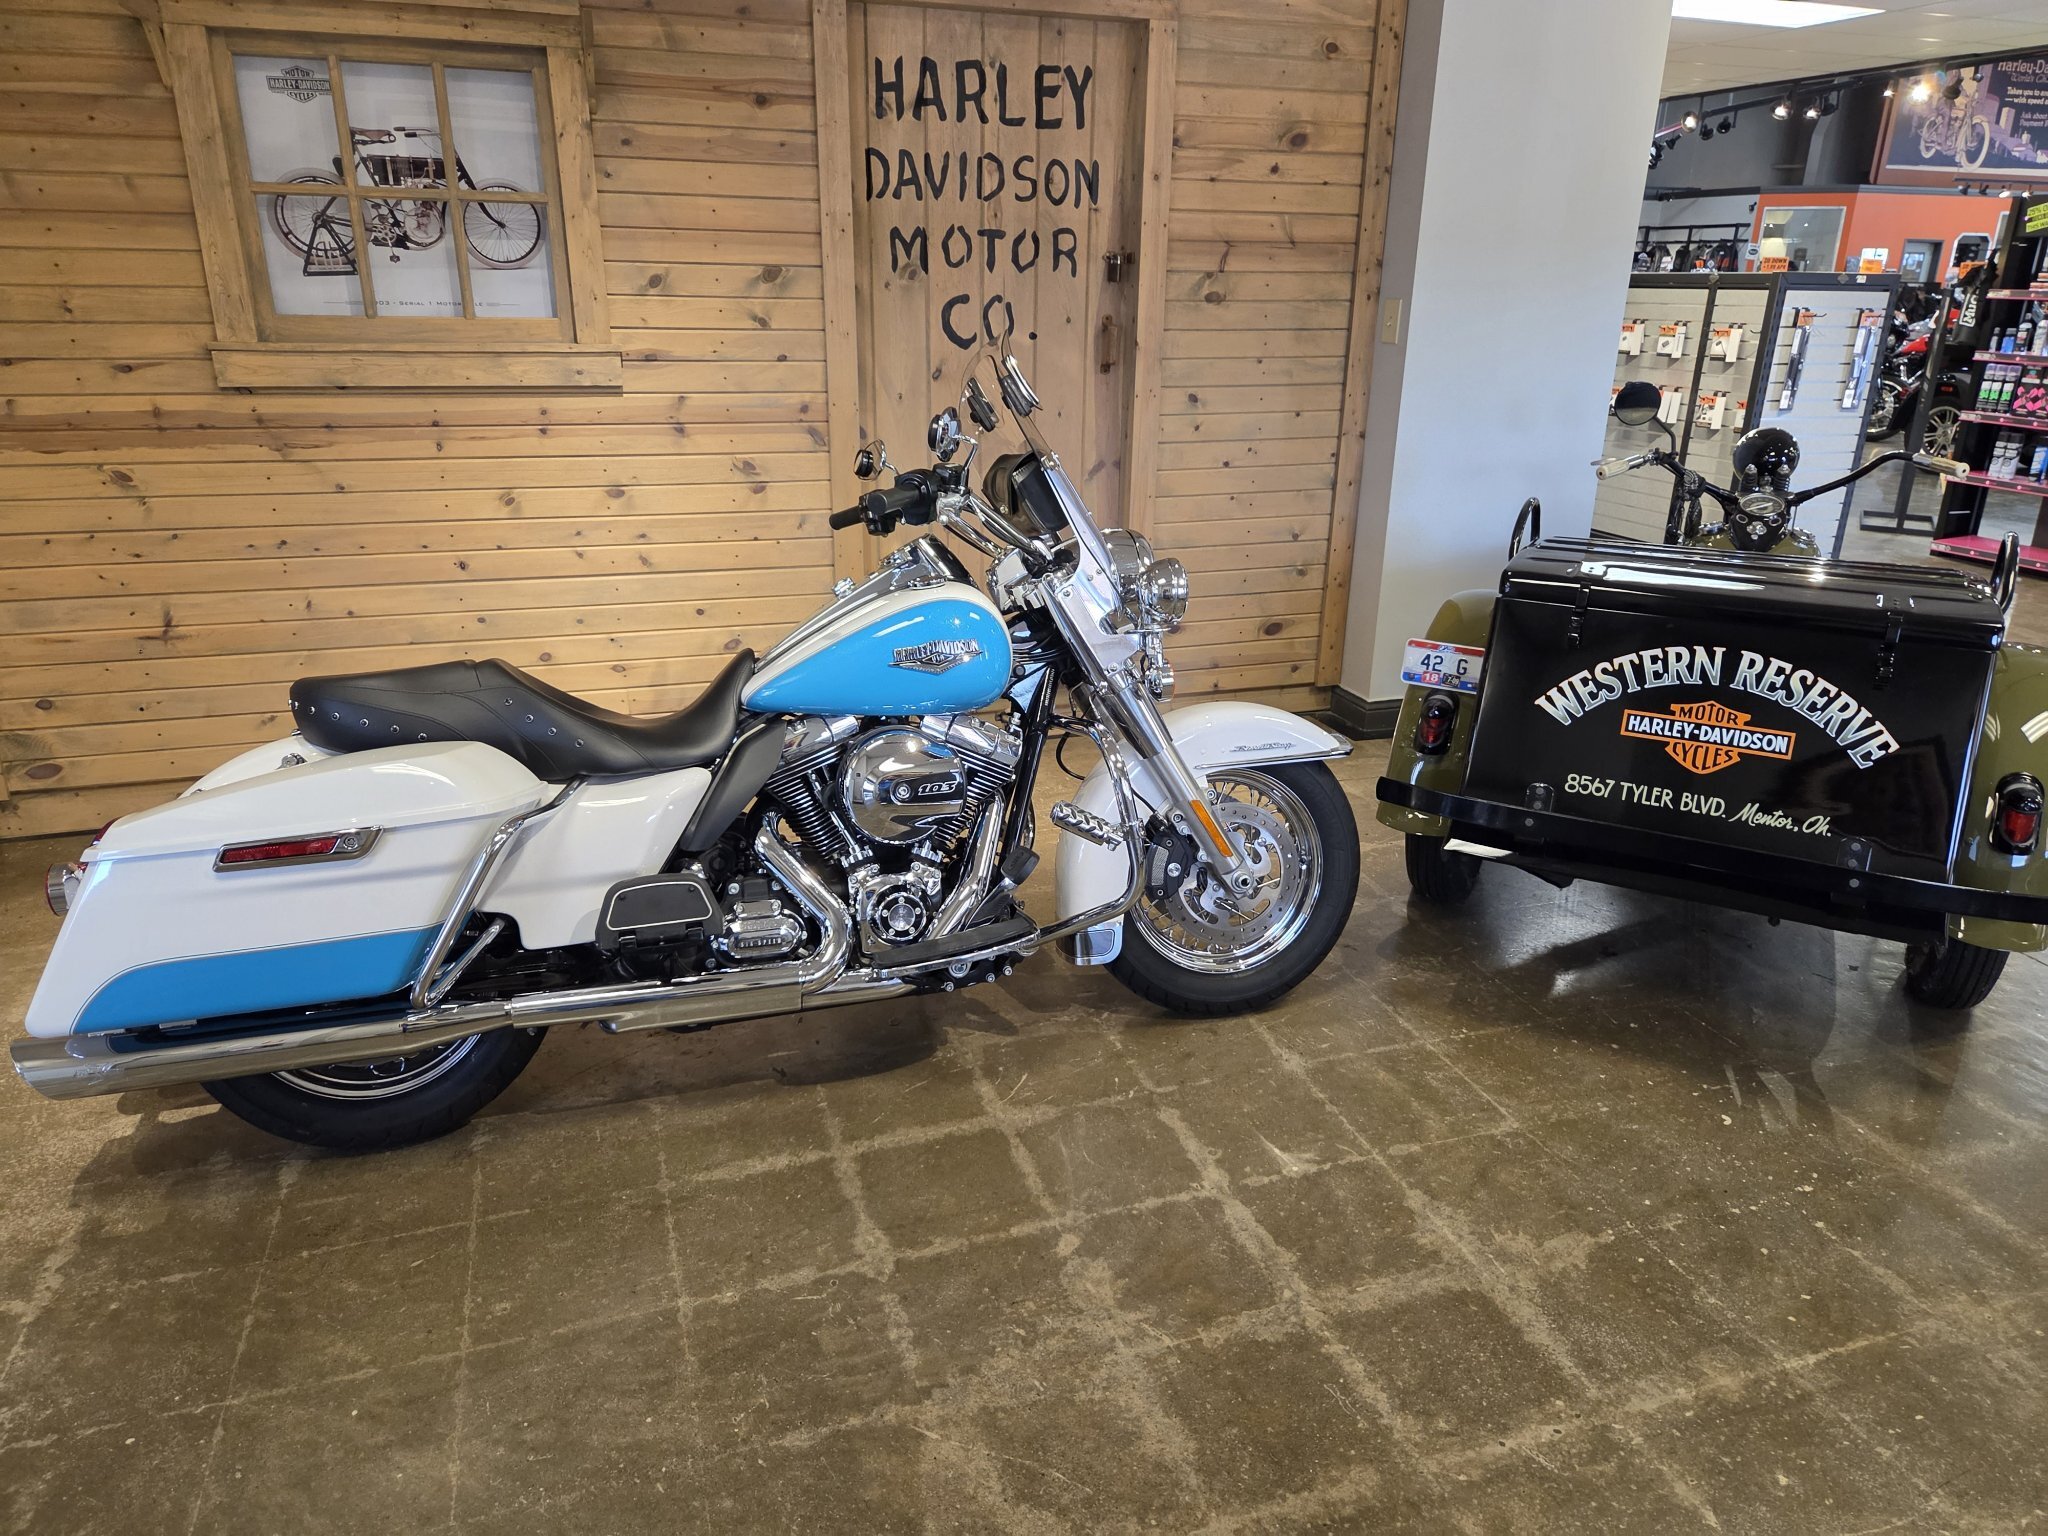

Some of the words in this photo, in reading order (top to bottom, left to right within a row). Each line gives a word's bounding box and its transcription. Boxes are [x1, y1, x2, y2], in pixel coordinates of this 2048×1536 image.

[269, 77, 331, 90] HARLEY-DAVIDSON
[284, 67, 311, 78] MOTOR
[289, 91, 315, 101] CYCLES
[874, 55, 1093, 131] HARLEY
[864, 147, 1100, 209] DAVIDSON
[889, 223, 1078, 278] MOTOR
[940, 293, 1038, 350] CO.
[1420, 653, 1444, 673] 42
[1456, 658, 1469, 676] G
[1424, 673, 1439, 683] 18
[1533, 645, 1727, 727] WESTERN
[1728, 649, 1901, 770] RESERVE
[1678, 702, 1739, 726] MOTOR
[1627, 715, 1789, 754] HARLEY-DAVIDSON
[1671, 741, 1736, 770] CYCLES
[1564, 773, 1615, 798] 8567
[1620, 781, 1674, 809] TYLER
[1680, 792, 1726, 819] BLVD.
[1729, 802, 1799, 832] Mentor,
[1802, 815, 1832, 837] Oh.
